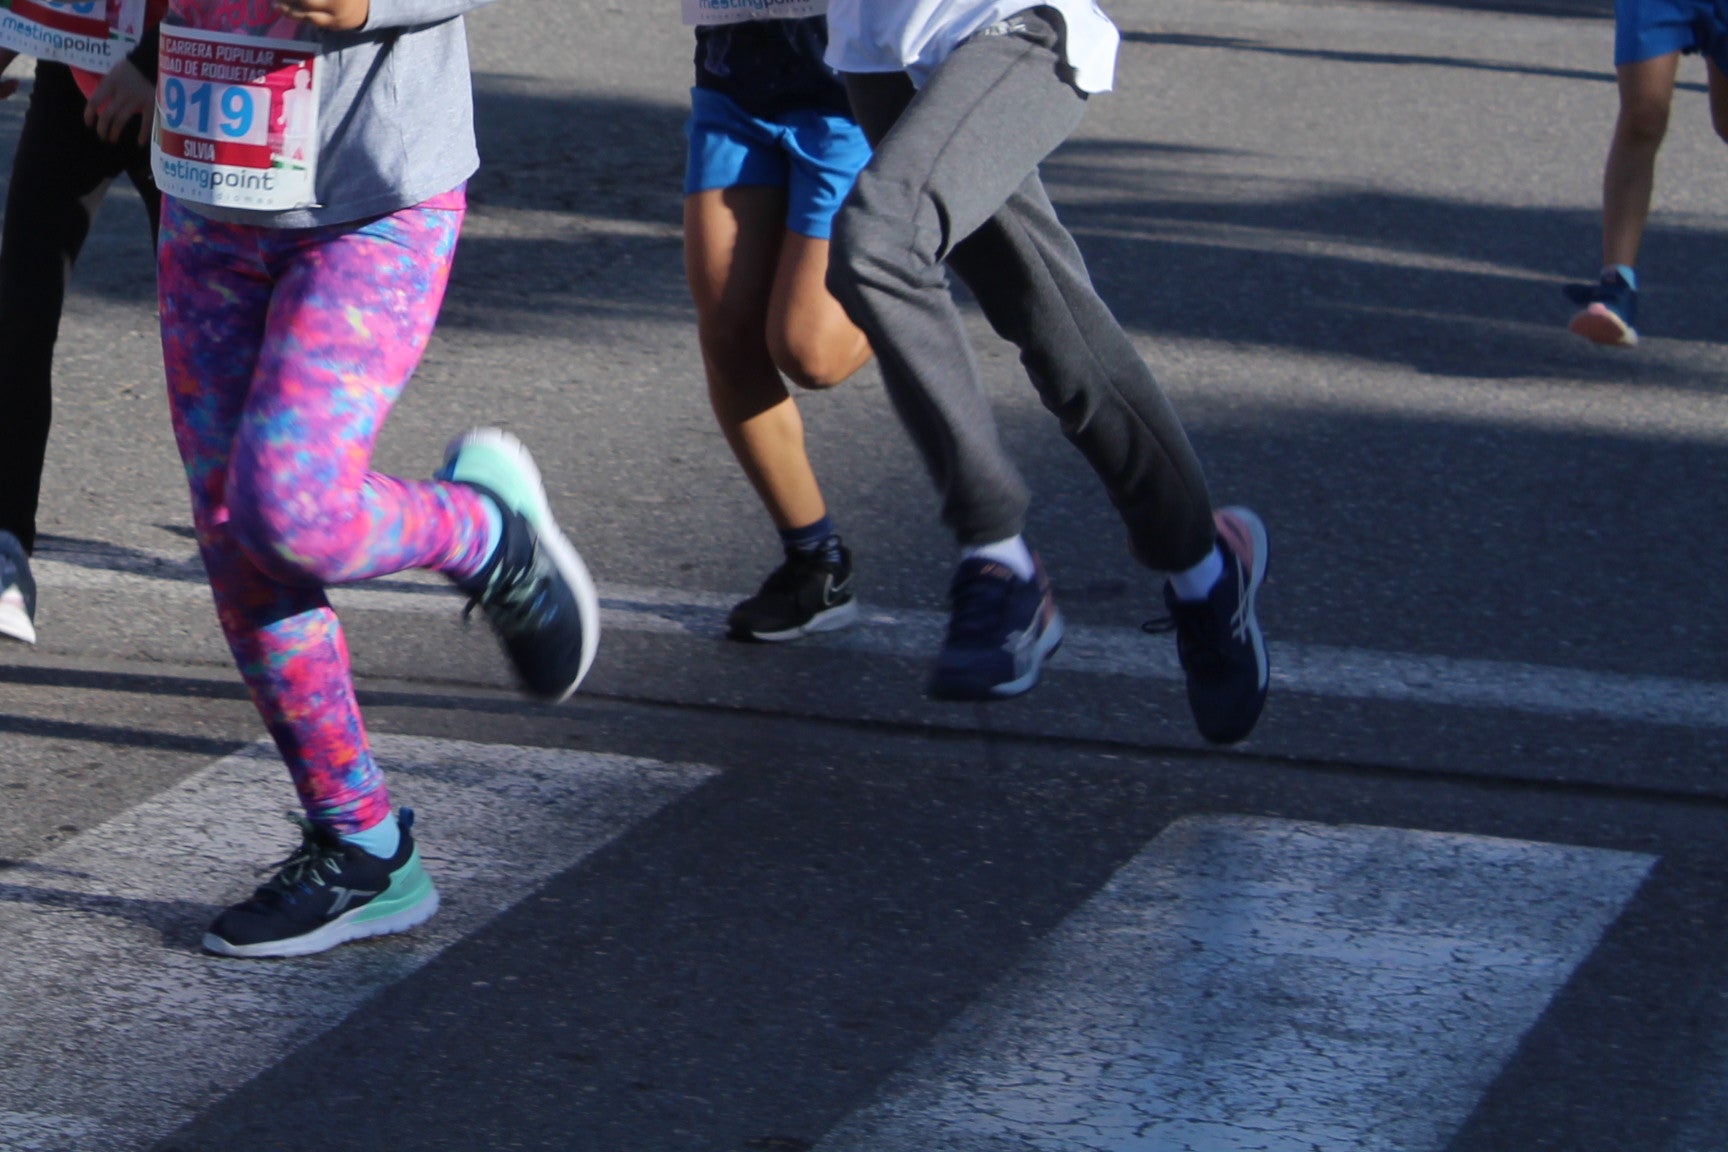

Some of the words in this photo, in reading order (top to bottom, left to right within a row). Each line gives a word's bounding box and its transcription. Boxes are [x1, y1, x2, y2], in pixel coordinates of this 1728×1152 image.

[166, 38, 213, 58] CARRERA
[215, 45, 275, 65] POPULAR
[184, 60, 199, 76] DE
[200, 62, 267, 84] ROQUETAS
[164, 77, 256, 138] 919
[183, 139, 217, 162] SILVIA
